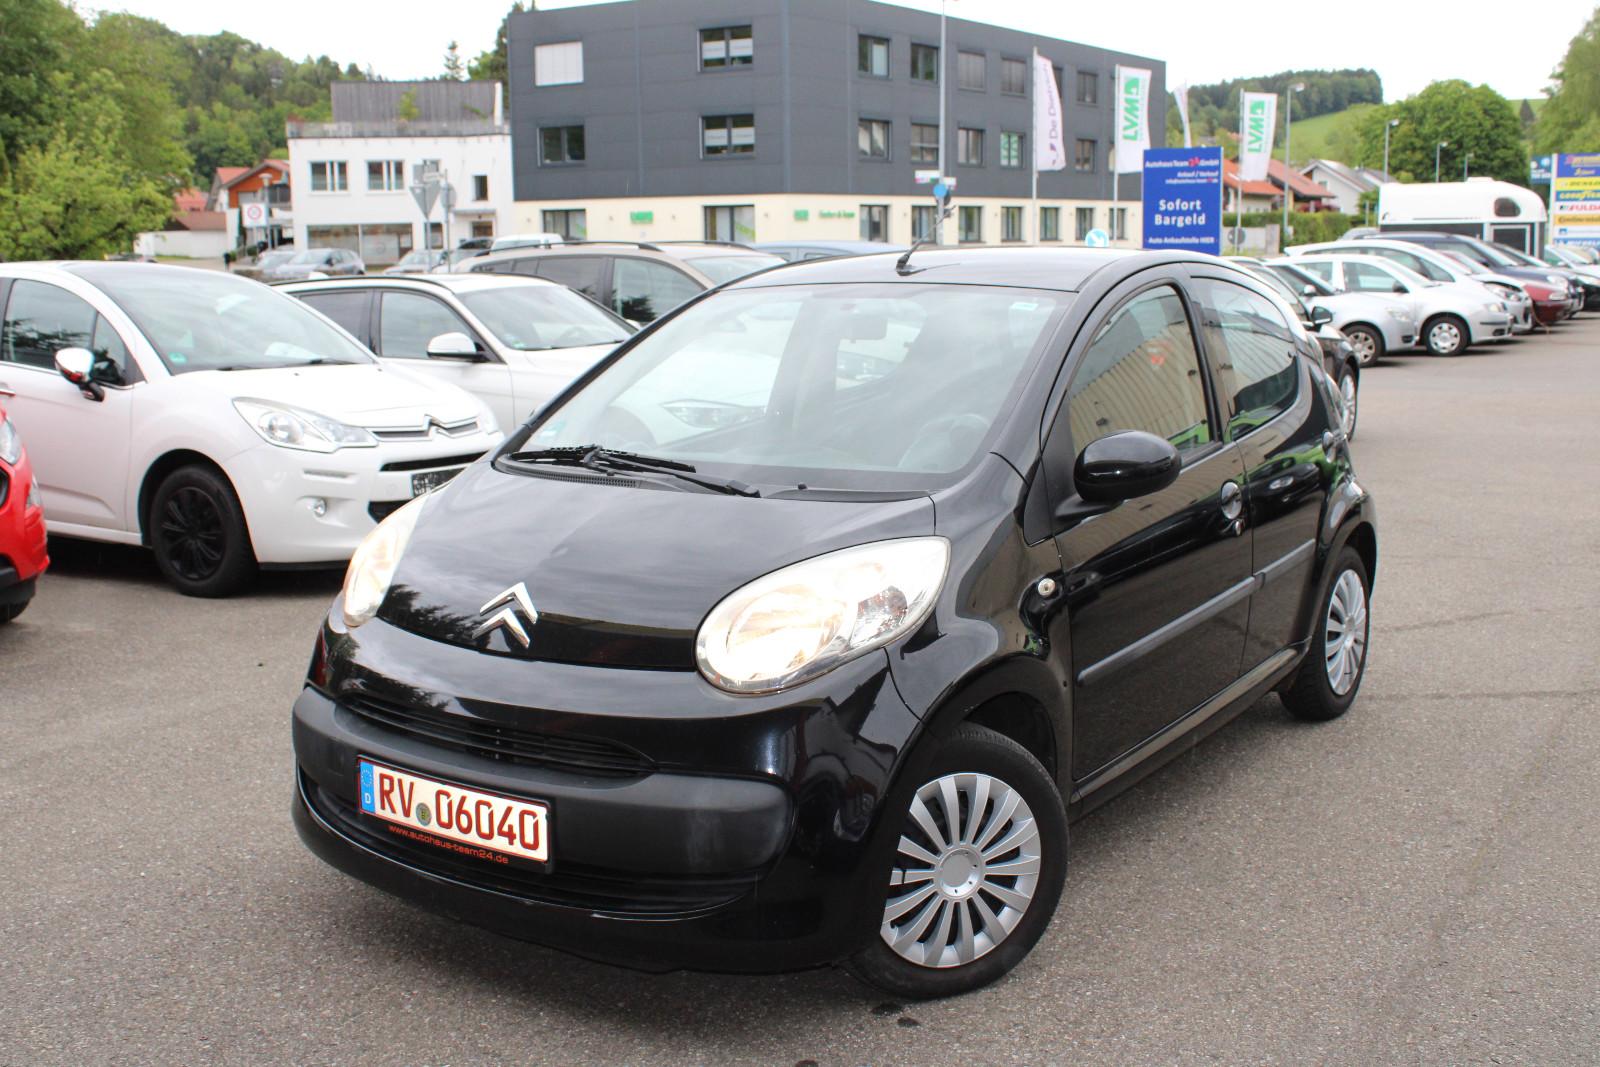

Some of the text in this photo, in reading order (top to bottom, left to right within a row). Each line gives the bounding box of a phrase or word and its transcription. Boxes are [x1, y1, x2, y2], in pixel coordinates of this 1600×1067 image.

[1122, 97, 1140, 141] LVM
[1247, 117, 1265, 153] LVM
[1154, 212, 1206, 228] Bargeld
[1158, 198, 1202, 211] Sofort
[364, 793, 372, 805] D
[379, 772, 540, 851] RV 06040
[387, 824, 509, 864] www.autohaus-team24.de
